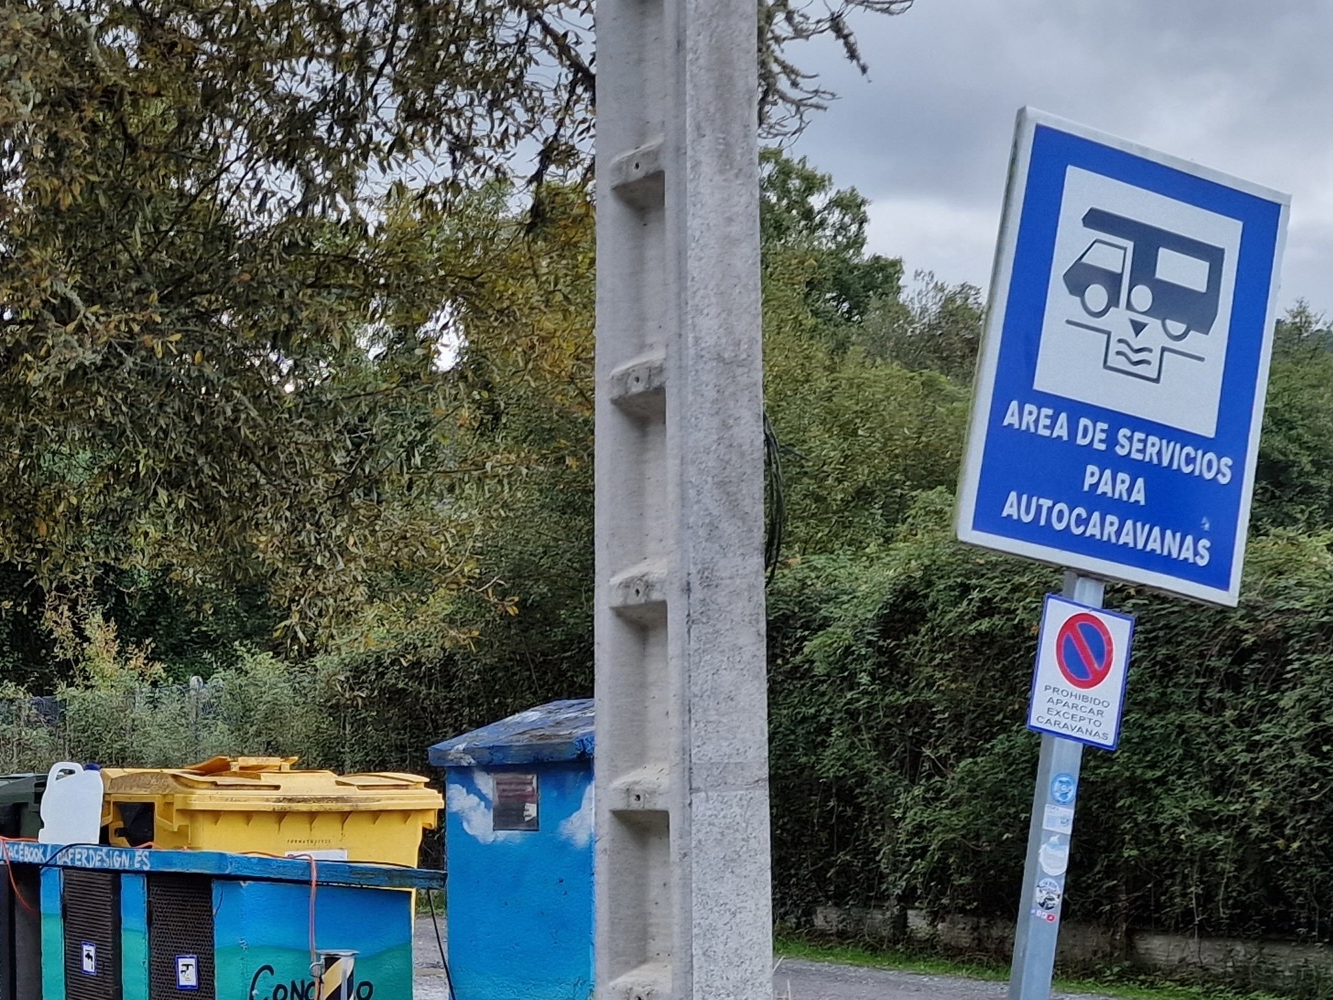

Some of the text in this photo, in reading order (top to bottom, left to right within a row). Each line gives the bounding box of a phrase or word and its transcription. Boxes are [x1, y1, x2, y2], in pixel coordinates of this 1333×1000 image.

[1003, 400, 1233, 485] AREA DE SERVICIOS
[1083, 464, 1146, 506] PARA
[1001, 491, 1211, 567] AUTOCARAVANAS
[1044, 685, 1110, 708] PROHIBIDO
[1046, 696, 1105, 718] APARCAR
[1036, 715, 1109, 741] CARAVANAS
[1046, 707, 1103, 728] EXCEPTO
